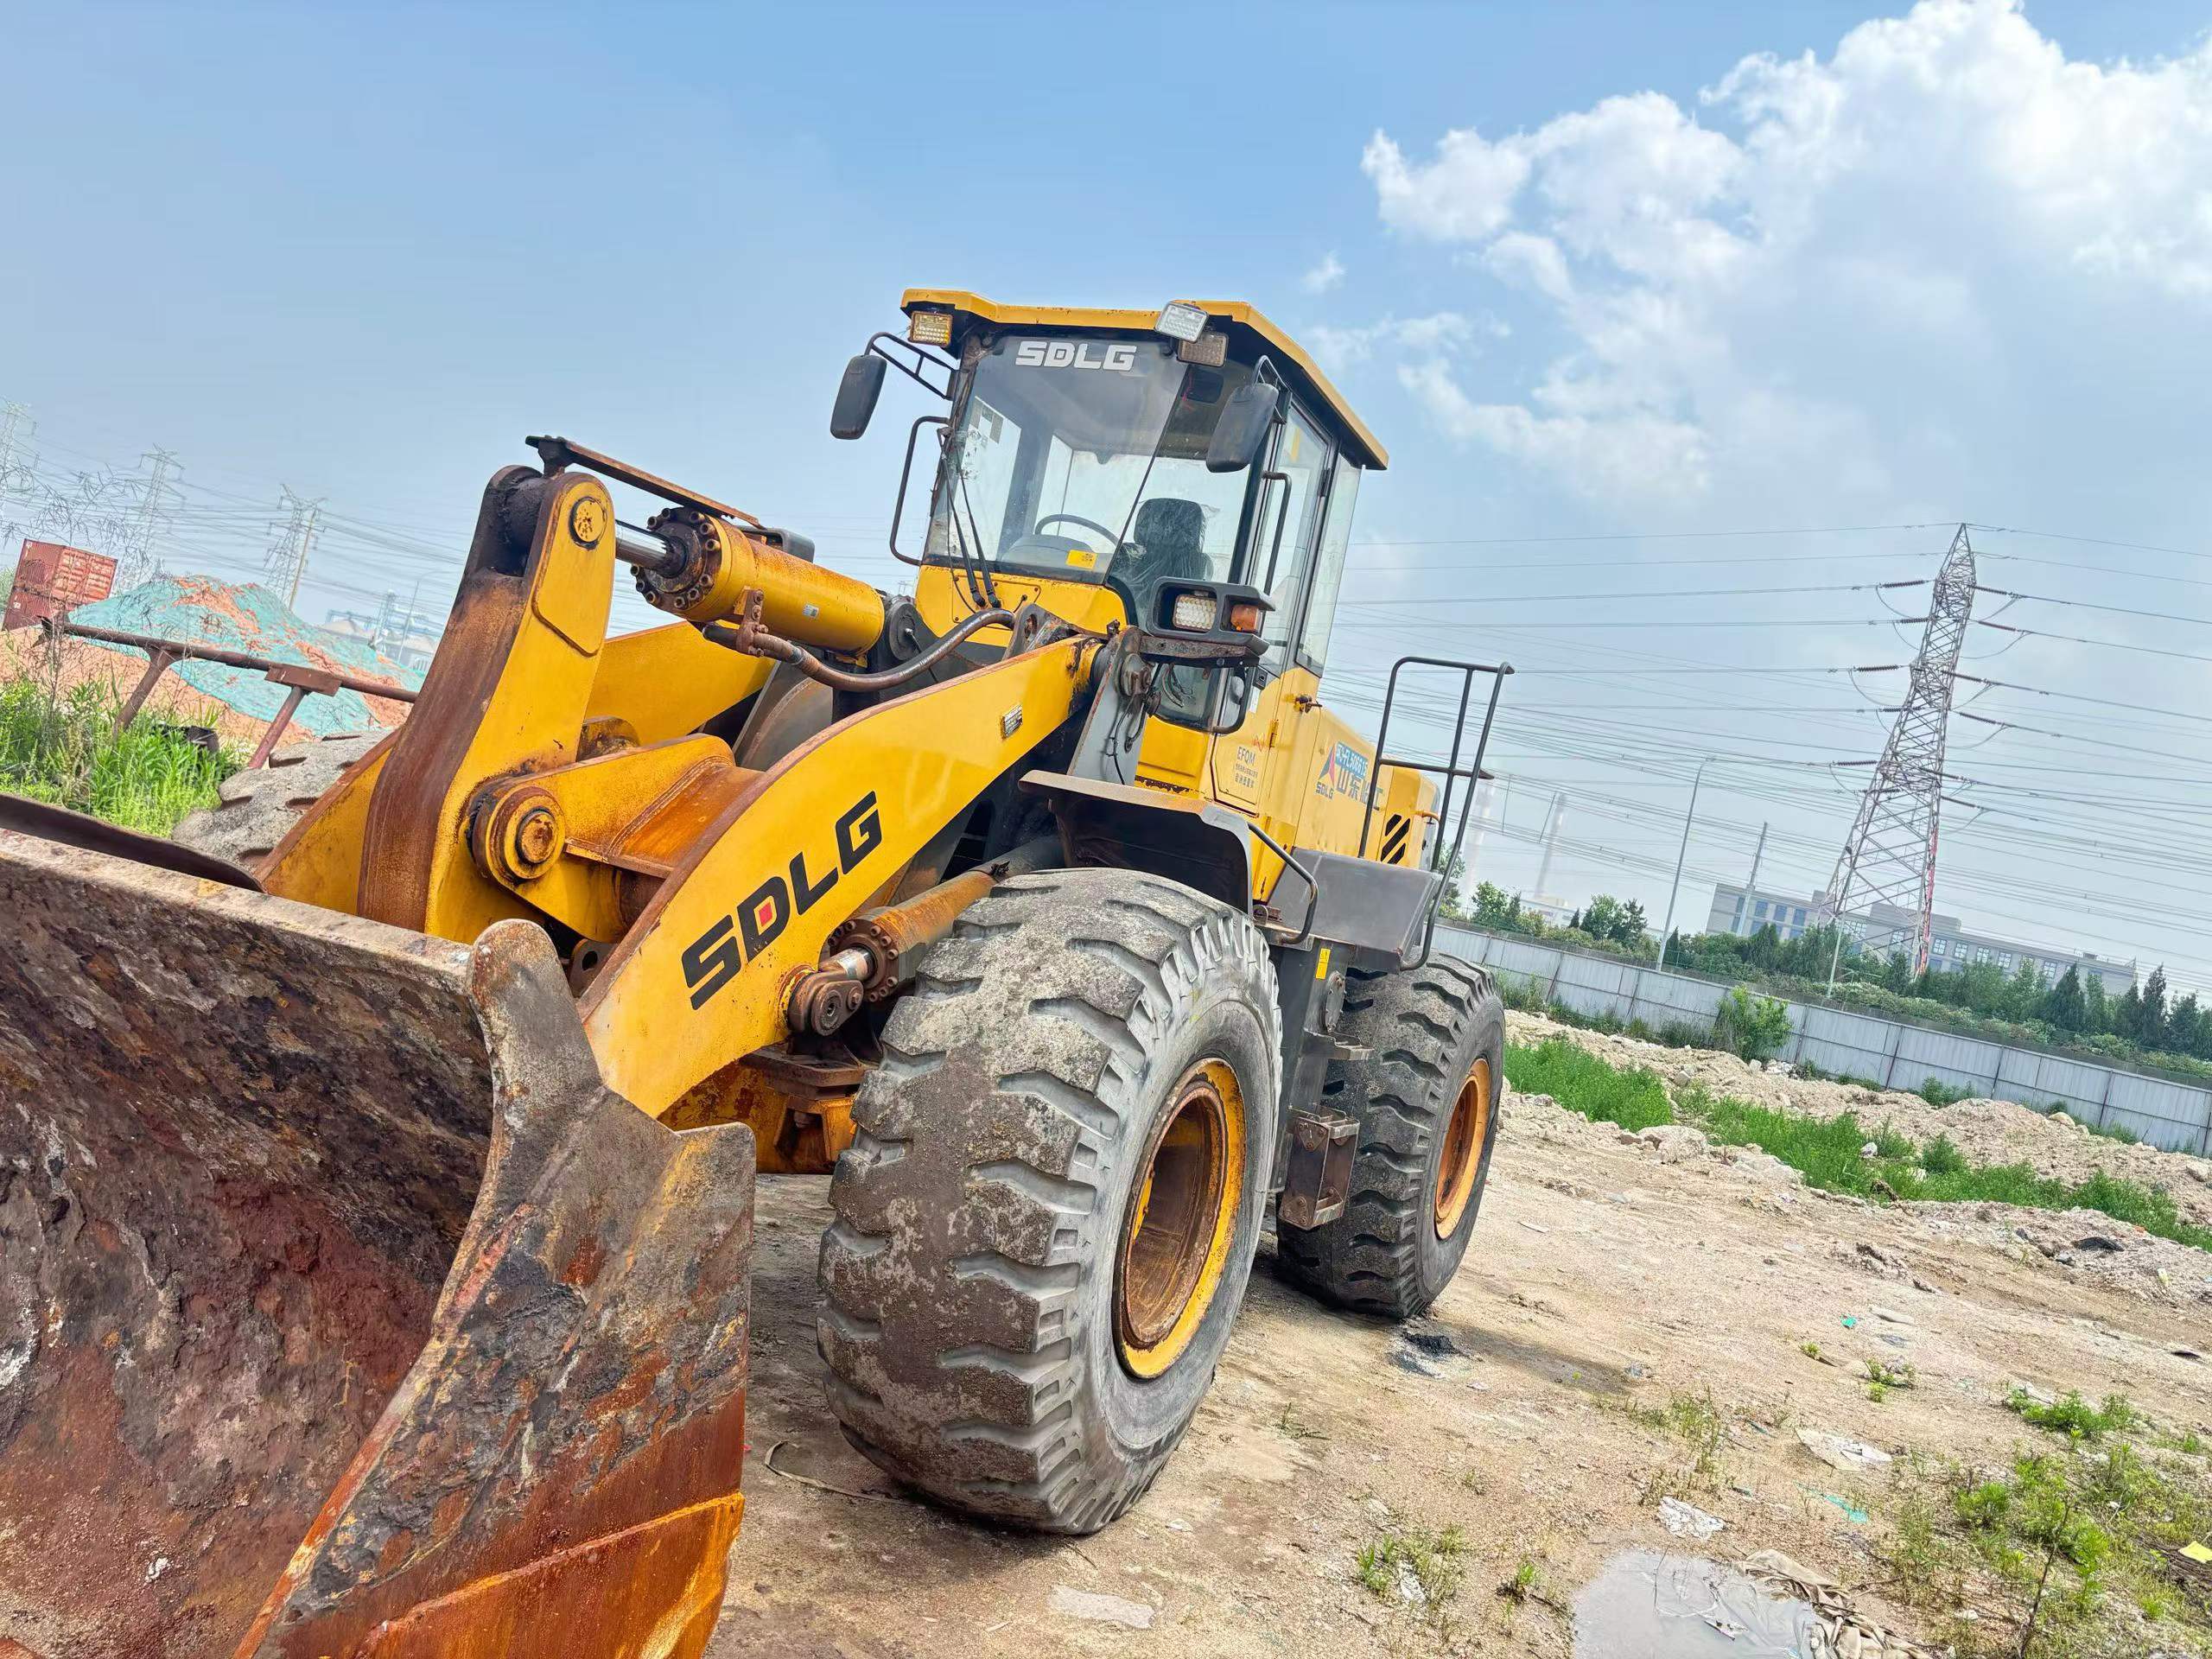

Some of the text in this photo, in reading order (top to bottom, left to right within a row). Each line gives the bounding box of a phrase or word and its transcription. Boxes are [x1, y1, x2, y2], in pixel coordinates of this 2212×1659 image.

[1015, 340, 1137, 372] SDLG
[1315, 781, 1334, 799] SDLG
[682, 791, 882, 1011] SDLG
